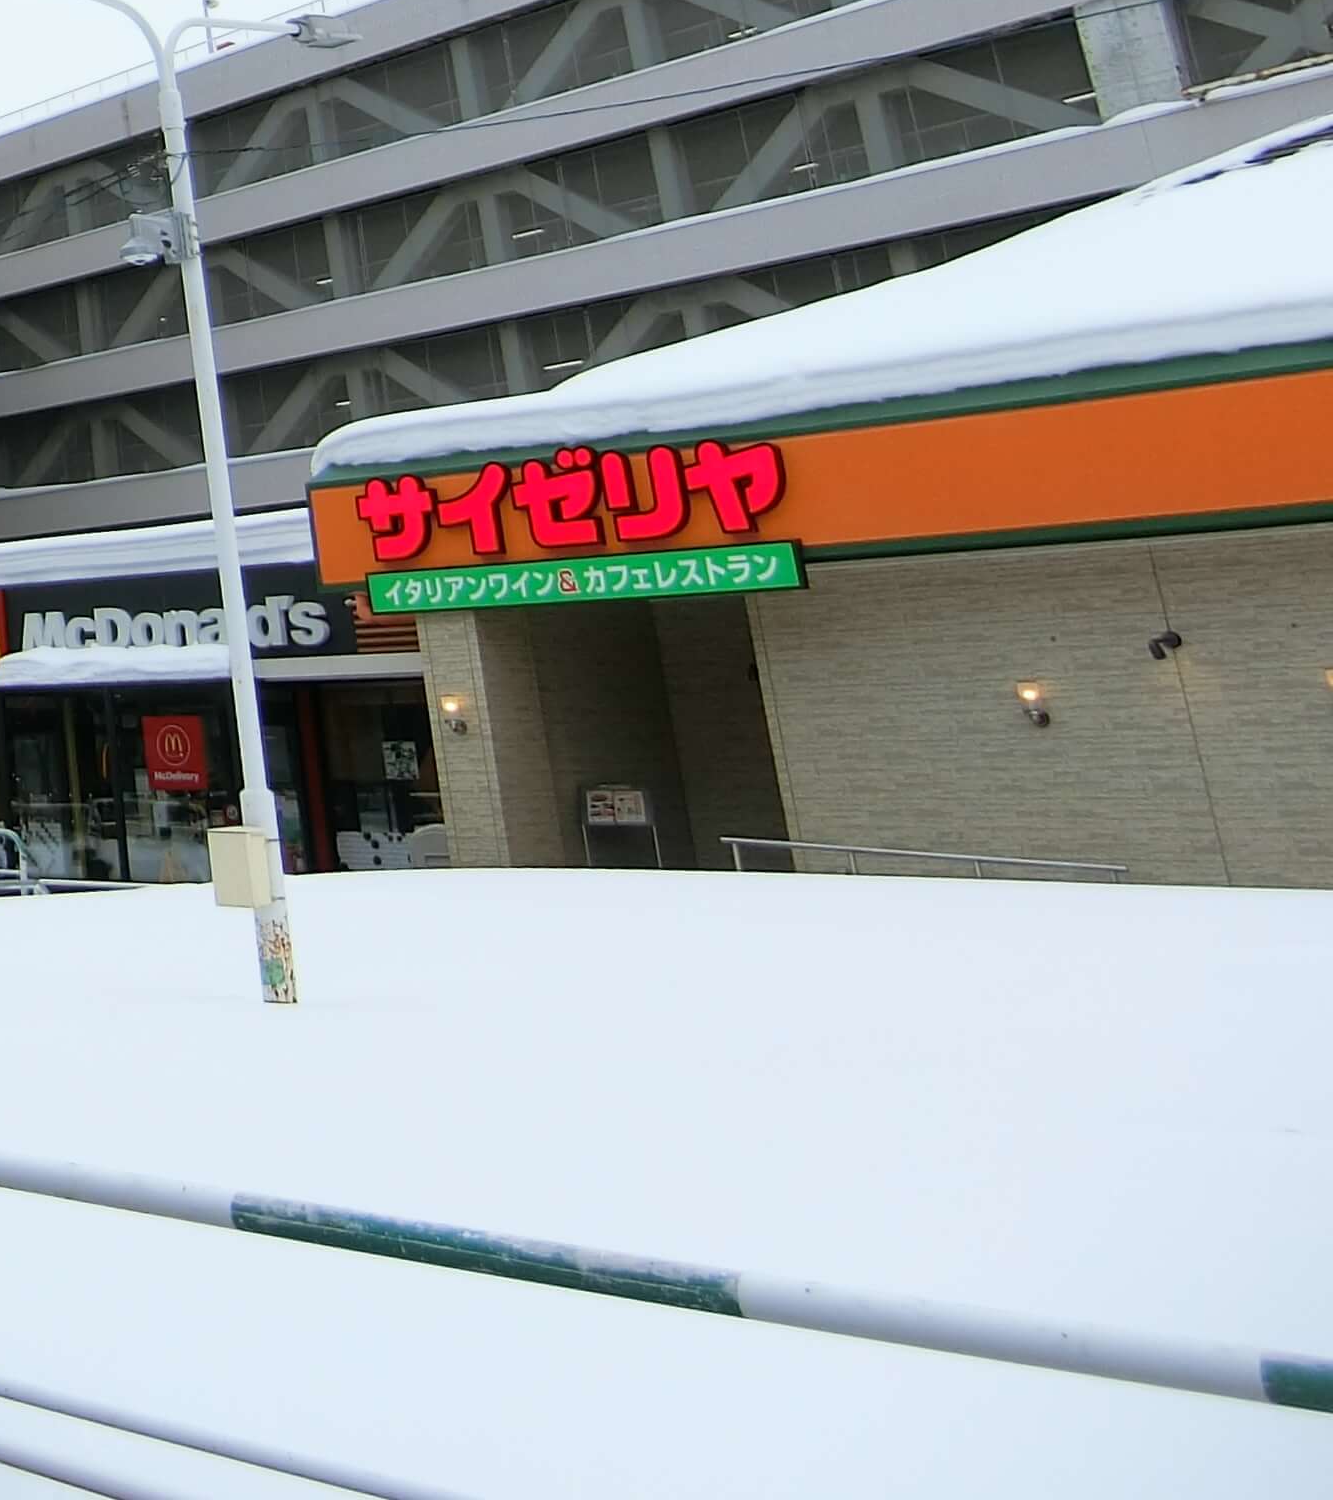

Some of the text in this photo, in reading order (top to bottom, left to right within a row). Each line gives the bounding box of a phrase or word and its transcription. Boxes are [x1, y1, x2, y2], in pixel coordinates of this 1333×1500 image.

[356, 438, 786, 562] サイゼリヤ
[22, 595, 331, 649] McDonad's
